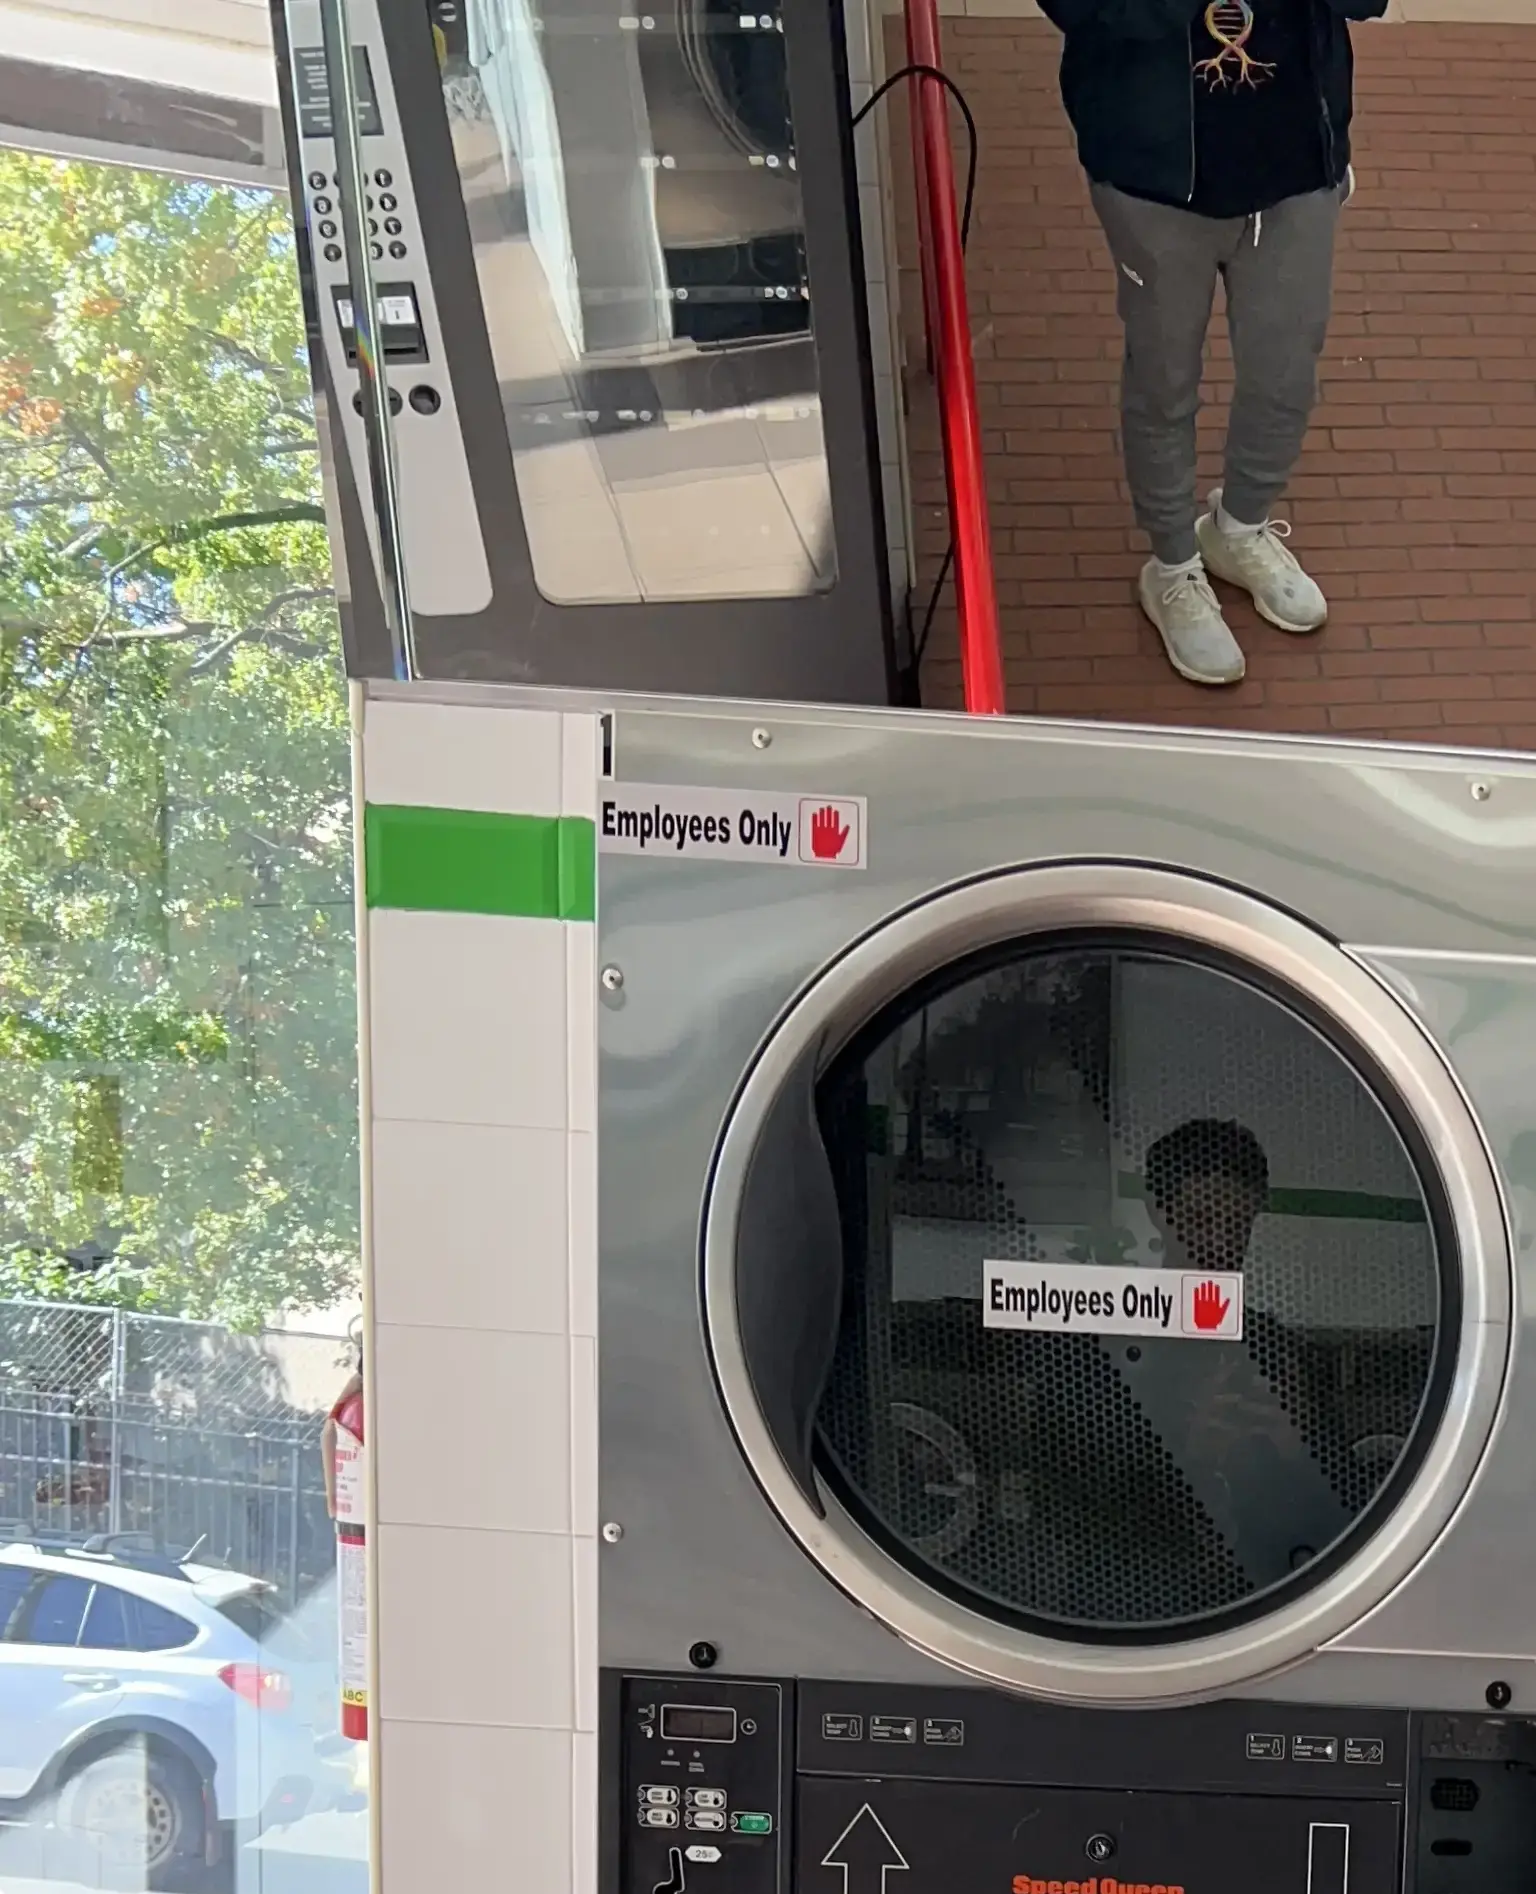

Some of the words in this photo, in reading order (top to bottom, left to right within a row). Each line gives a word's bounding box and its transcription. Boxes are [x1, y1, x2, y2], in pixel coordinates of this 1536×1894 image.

[601, 713, 613, 777] 1
[602, 800, 731, 850] Employees
[738, 808, 792, 857] Only
[991, 1277, 1115, 1324] Employees
[1122, 1284, 1173, 1328] Only
